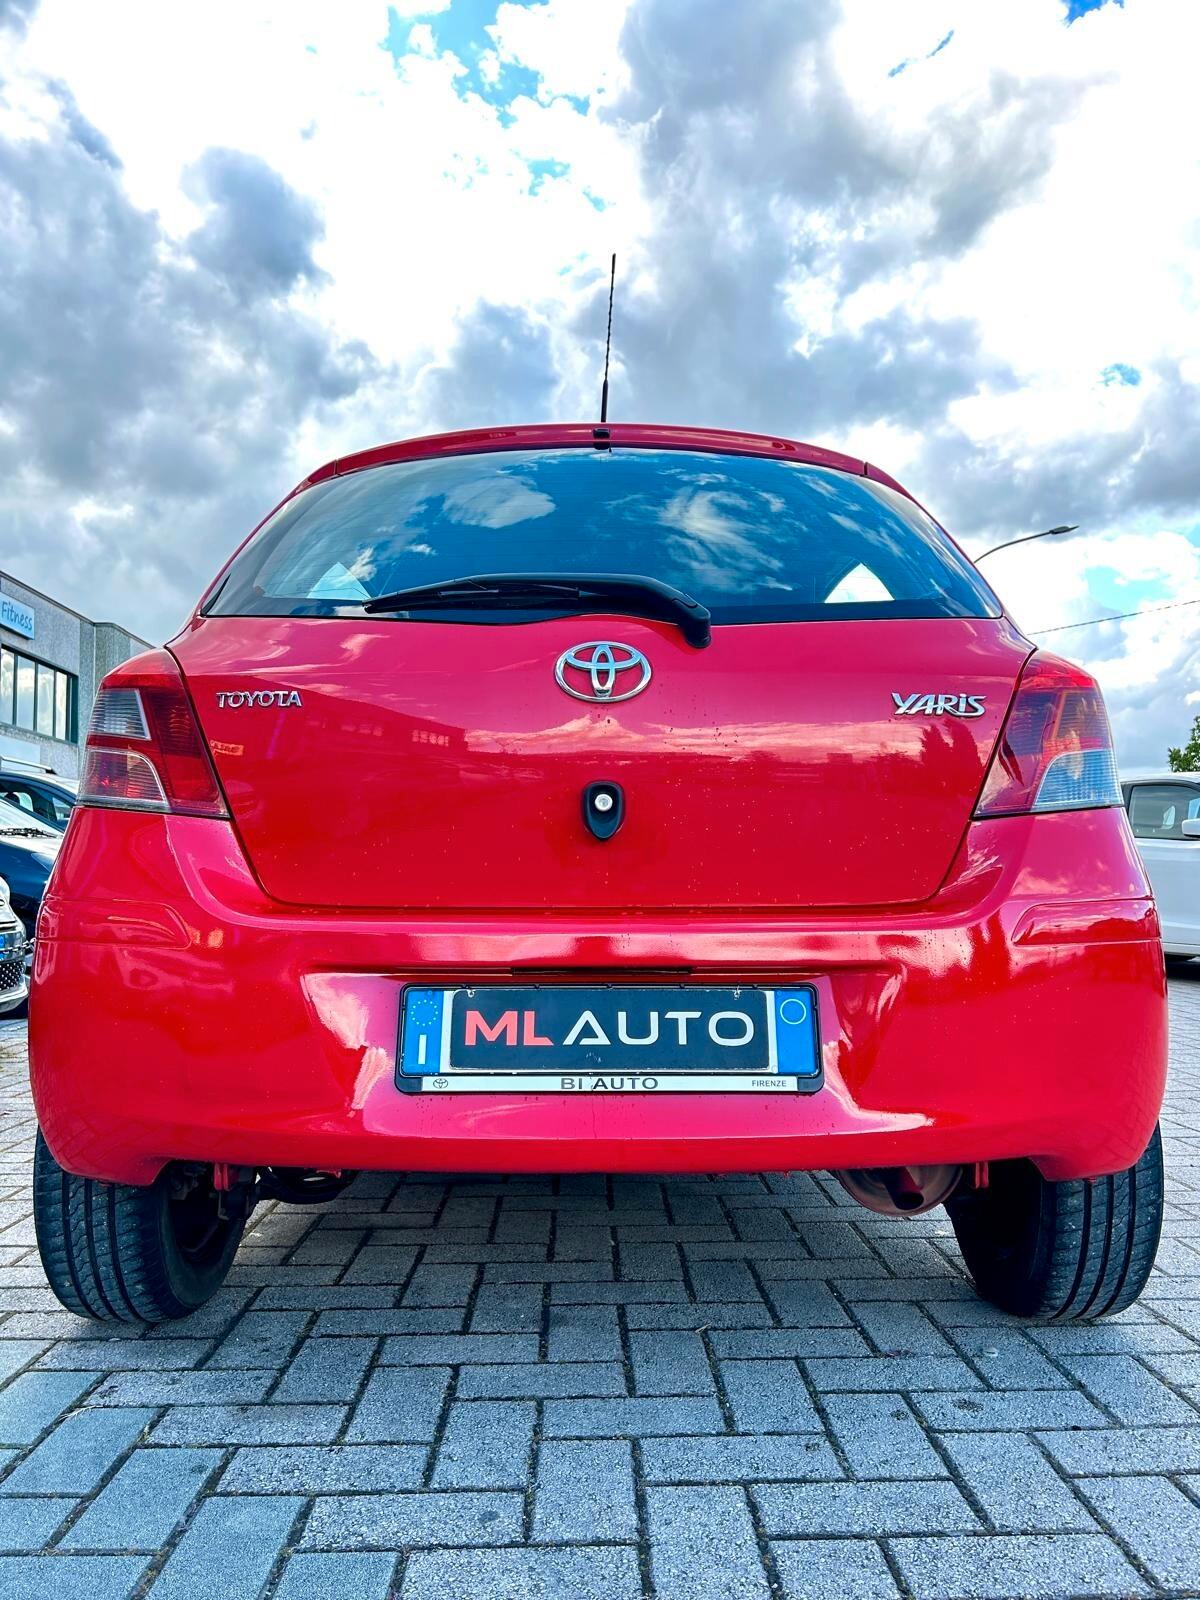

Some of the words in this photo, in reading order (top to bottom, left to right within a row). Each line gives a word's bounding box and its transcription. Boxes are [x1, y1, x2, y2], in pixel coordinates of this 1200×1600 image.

[1, 601, 33, 631] Fitness
[216, 690, 303, 708] TOYOTA
[464, 1010, 554, 1046] ML
[562, 1010, 755, 1046] AUTO
[560, 1077, 583, 1090] BI
[592, 1077, 659, 1090] AUTO
[751, 1079, 787, 1087] FIRENZE
